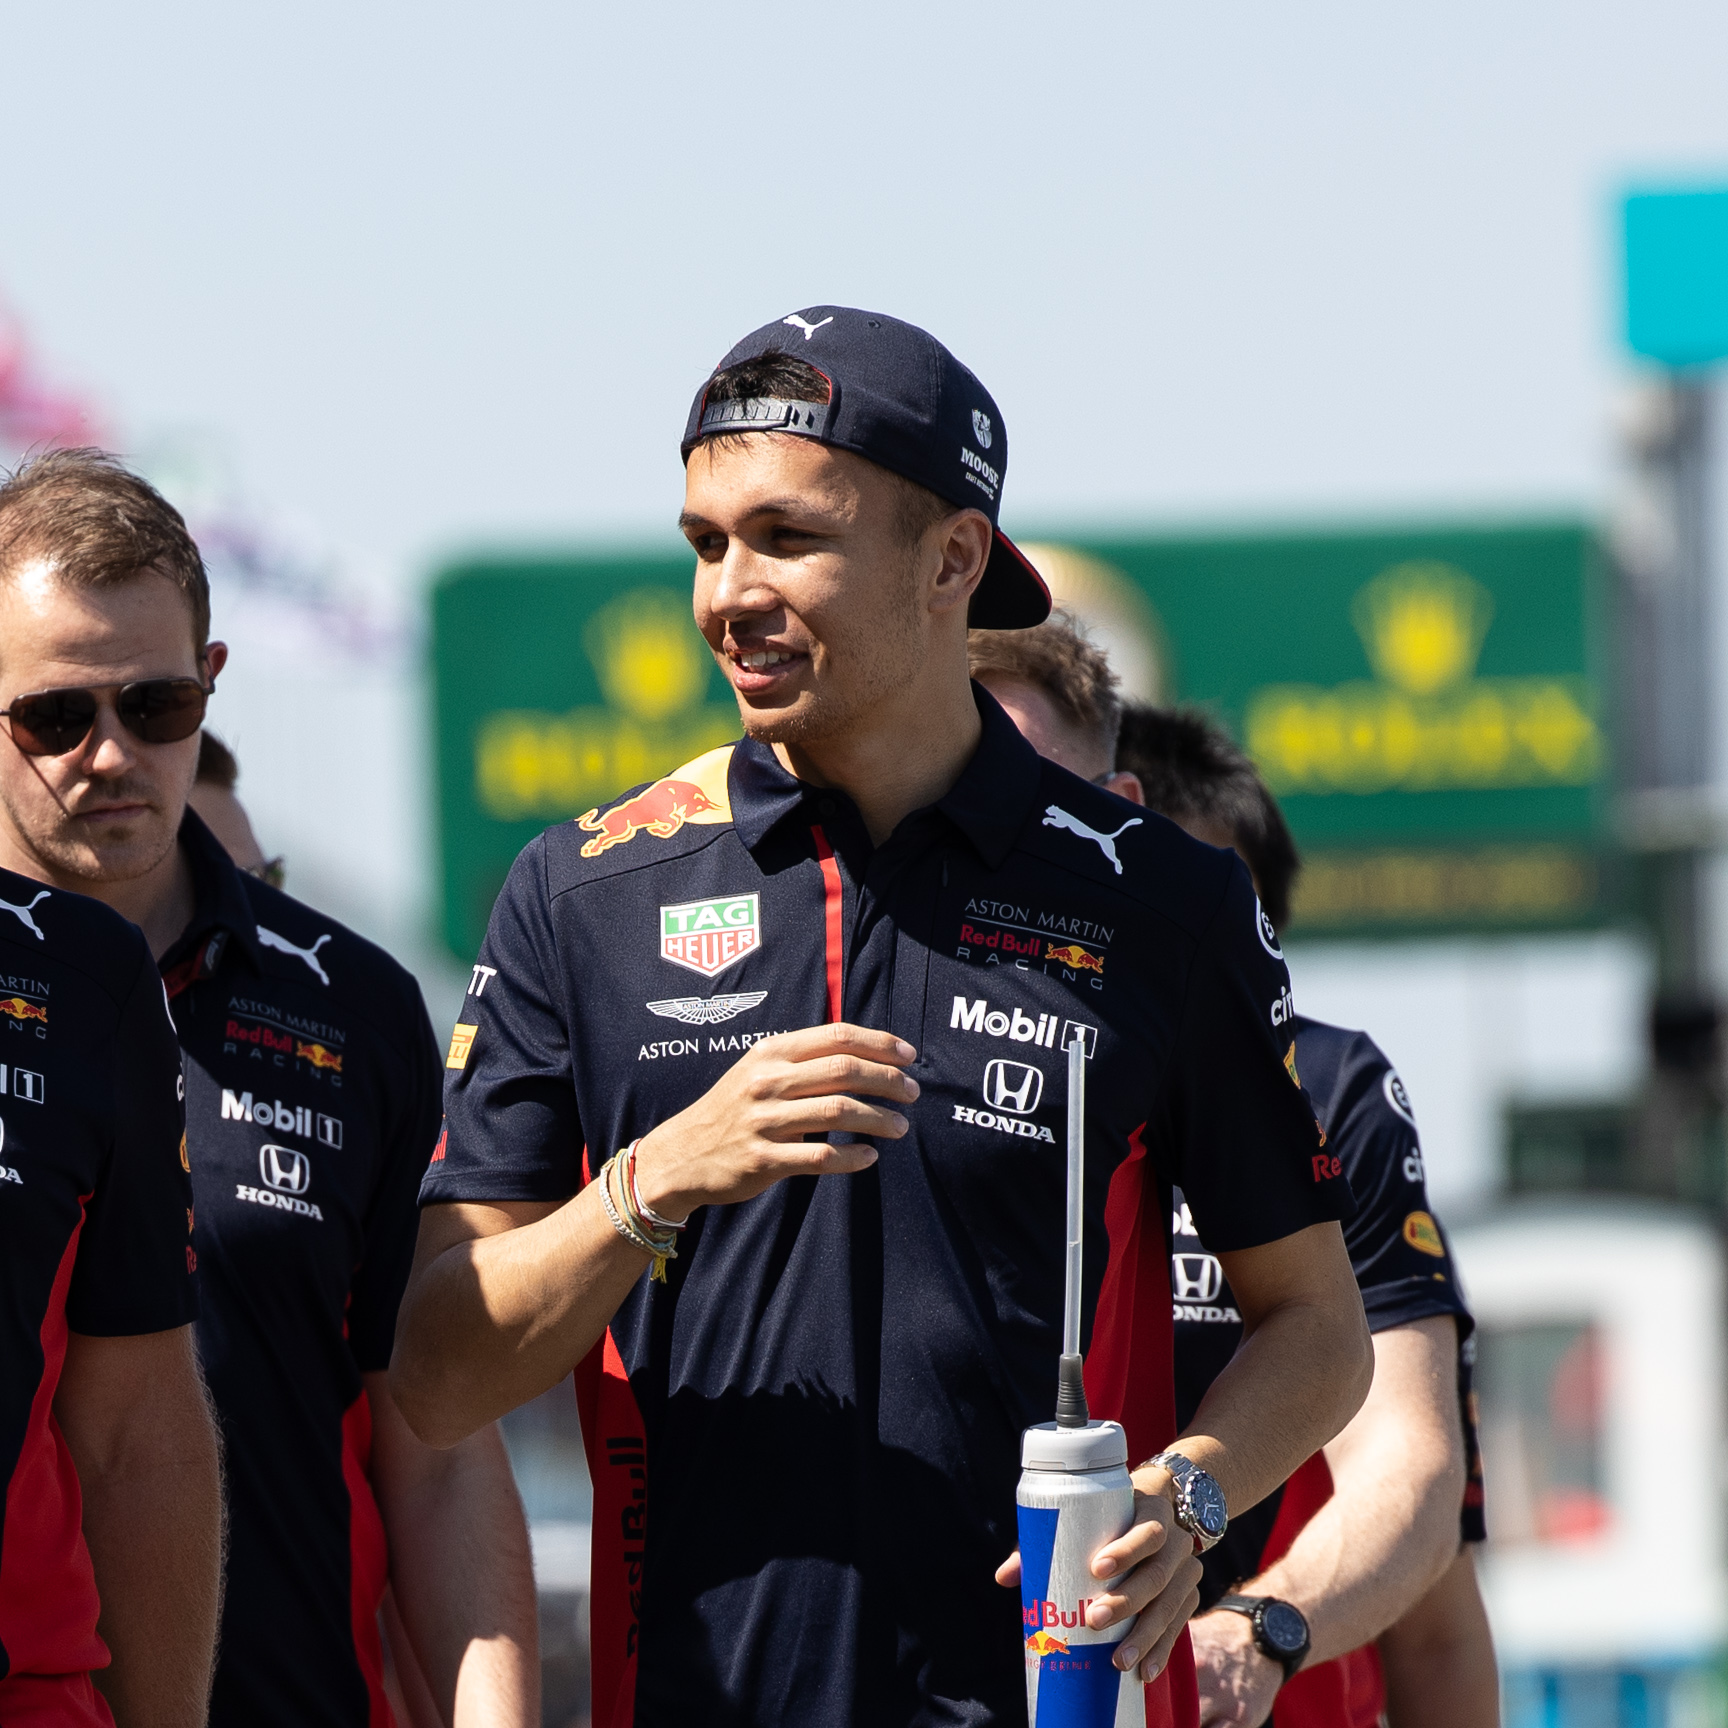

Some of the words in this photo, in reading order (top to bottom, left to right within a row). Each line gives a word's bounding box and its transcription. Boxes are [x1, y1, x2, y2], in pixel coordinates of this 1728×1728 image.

[961, 447, 999, 489] MOOSE
[669, 902, 749, 932] TAG
[965, 898, 1029, 922] ASTON
[1037, 911, 1114, 943] MARTIN
[667, 930, 753, 969] HEUER
[960, 924, 1001, 948] Red
[1002, 934, 1041, 957] Bull
[956, 946, 1103, 990] RACING
[226, 1020, 260, 1043] Red
[263, 1028, 293, 1053] Bull
[227, 997, 282, 1021] ASTON
[286, 1013, 346, 1043] MARTIN
[950, 996, 1058, 1048] Mobil
[223, 1042, 342, 1088] RACING
[638, 1038, 699, 1061] ASTON
[709, 1030, 787, 1052] MART
[221, 1088, 312, 1138] Mobil
[952, 1105, 1056, 1144] HONDA
[1312, 1154, 1343, 1183] Re
[235, 1184, 324, 1221] HONDA
[1173, 1304, 1242, 1323] ONDA
[1041, 1598, 1093, 1628] Bul
